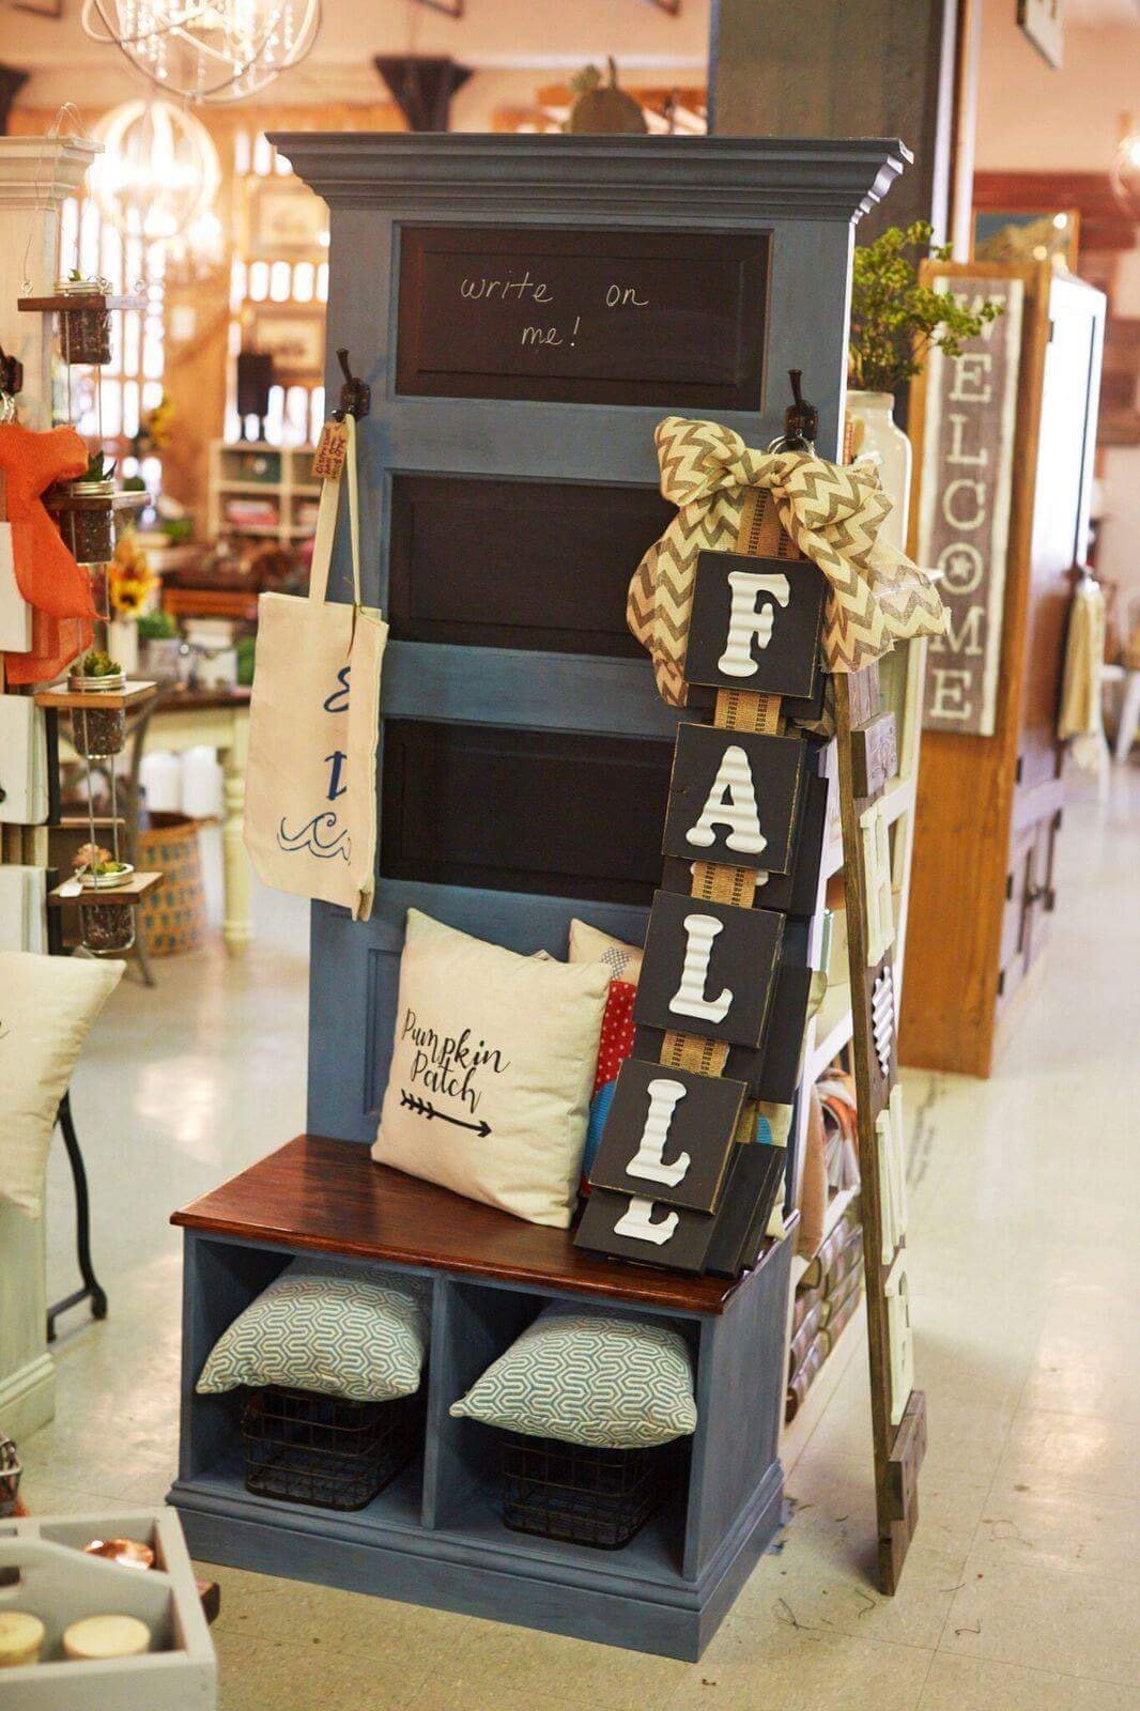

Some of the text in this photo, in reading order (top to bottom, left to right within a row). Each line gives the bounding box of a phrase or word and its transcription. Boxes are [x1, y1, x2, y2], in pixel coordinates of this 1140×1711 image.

[460, 270, 650, 307] write on
[521, 316, 581, 347] me!
[625, 570, 791, 1188] FALL
[402, 1007, 512, 1074] Pumpkin
[411, 1050, 482, 1115] Patch
